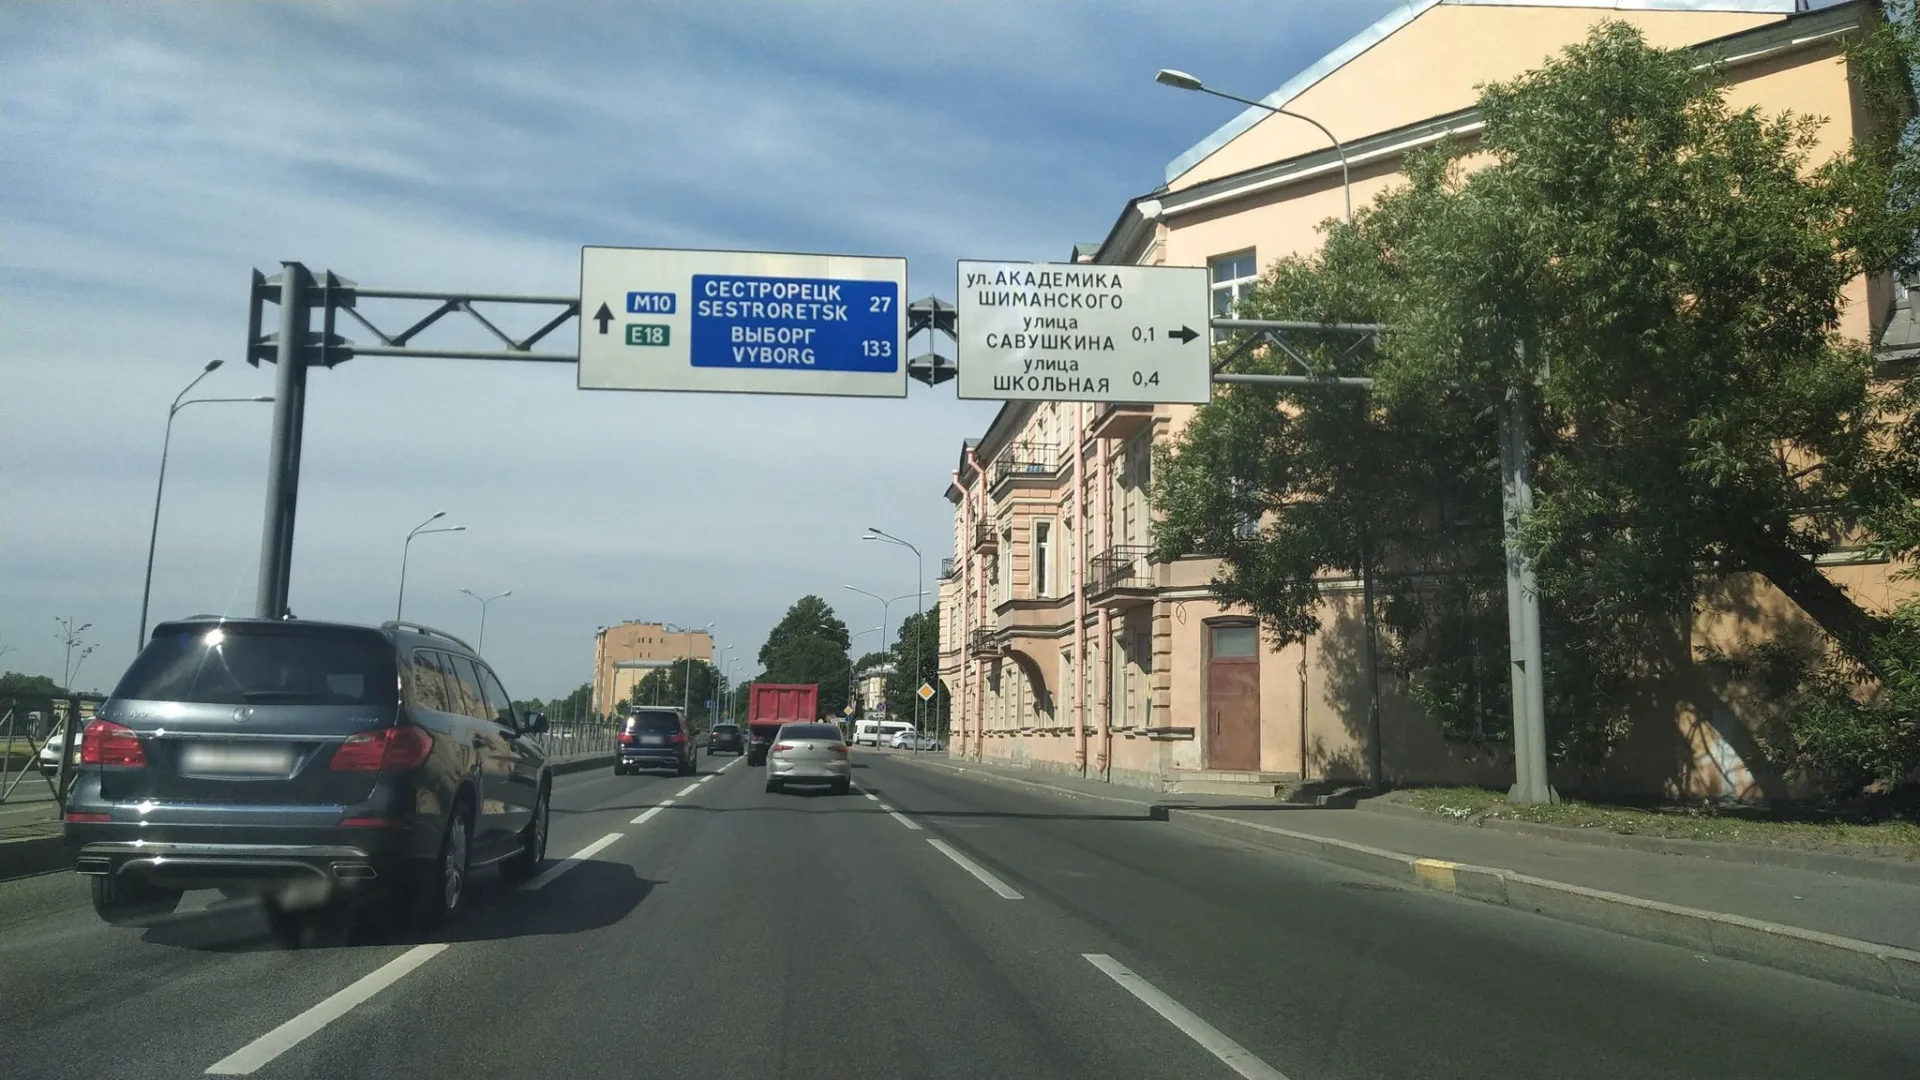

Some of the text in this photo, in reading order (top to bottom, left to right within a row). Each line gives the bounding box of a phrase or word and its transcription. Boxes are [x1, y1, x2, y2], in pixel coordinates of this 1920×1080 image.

[705, 280, 842, 301] СЕСТРОРЕЦК
[869, 296, 891, 313] 27
[979, 291, 1123, 309] ШИМАНСКОГО
[698, 301, 849, 321] SESTRORETSK
[1023, 316, 1078, 331] улица
[731, 326, 816, 344] ВЫБОРГ
[986, 333, 1115, 350] САВУШКИНА
[1132, 326, 1155, 343] 0,1
[732, 346, 816, 365] VYBORG
[861, 340, 892, 358] 133
[1023, 358, 1079, 374] улица
[993, 376, 1110, 393] ШКОЛЬНАЯ
[1132, 372, 1160, 388] 0,4
